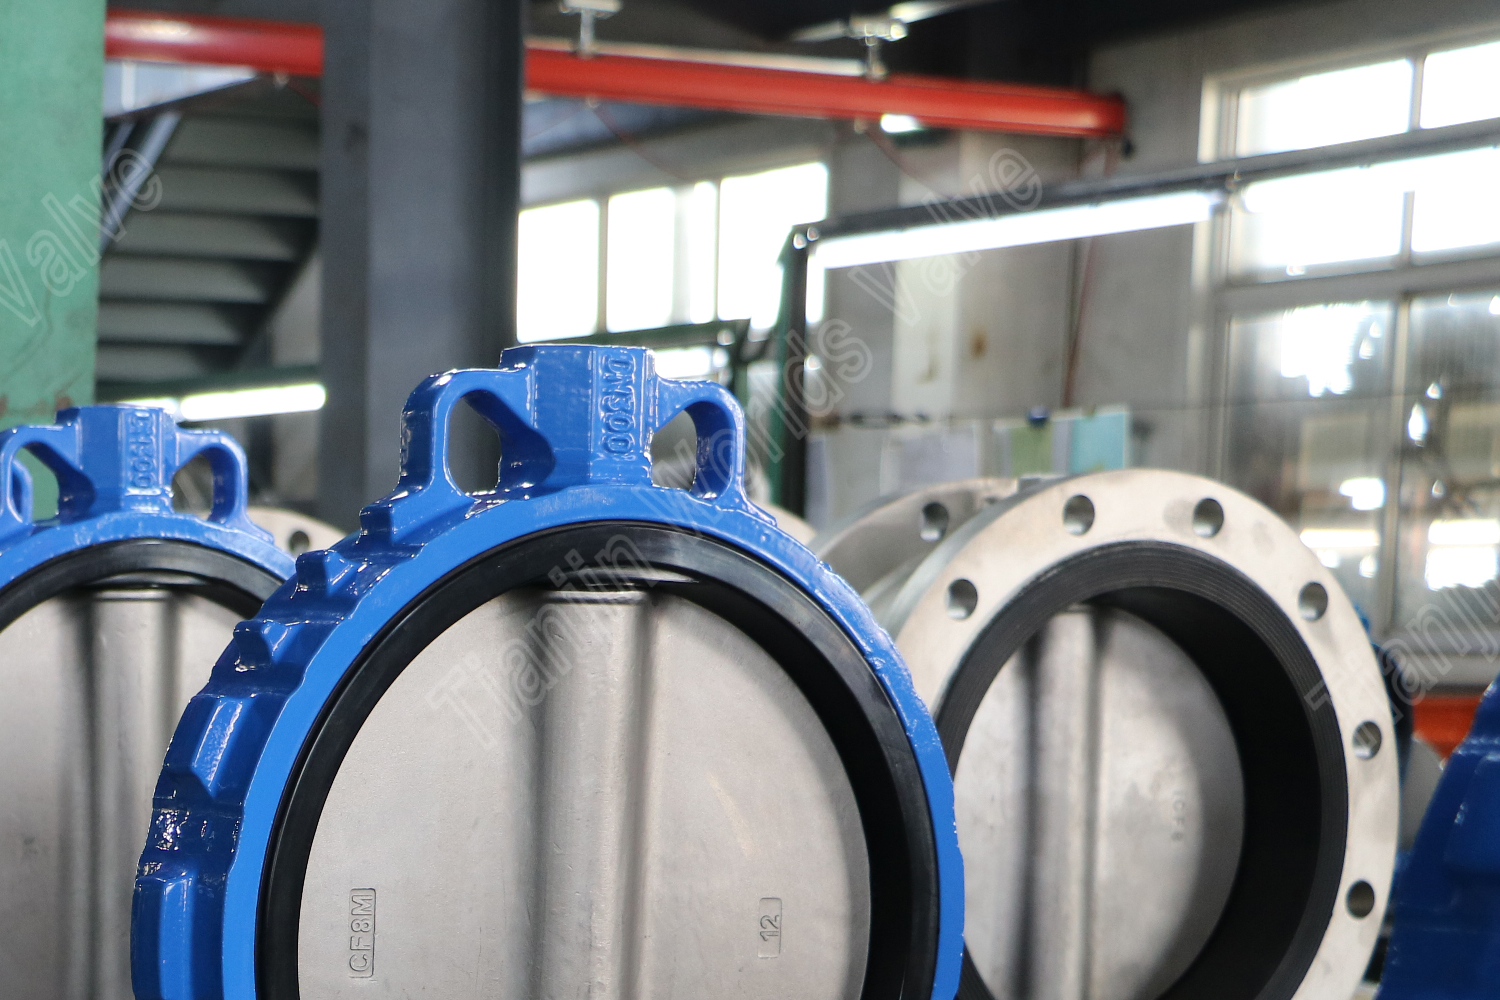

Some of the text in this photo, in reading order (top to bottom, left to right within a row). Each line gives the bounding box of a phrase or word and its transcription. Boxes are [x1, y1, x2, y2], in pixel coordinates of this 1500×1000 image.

[601, 352, 637, 456] DN300
[348, 894, 374, 972] CF8M
[759, 914, 780, 942] 12
